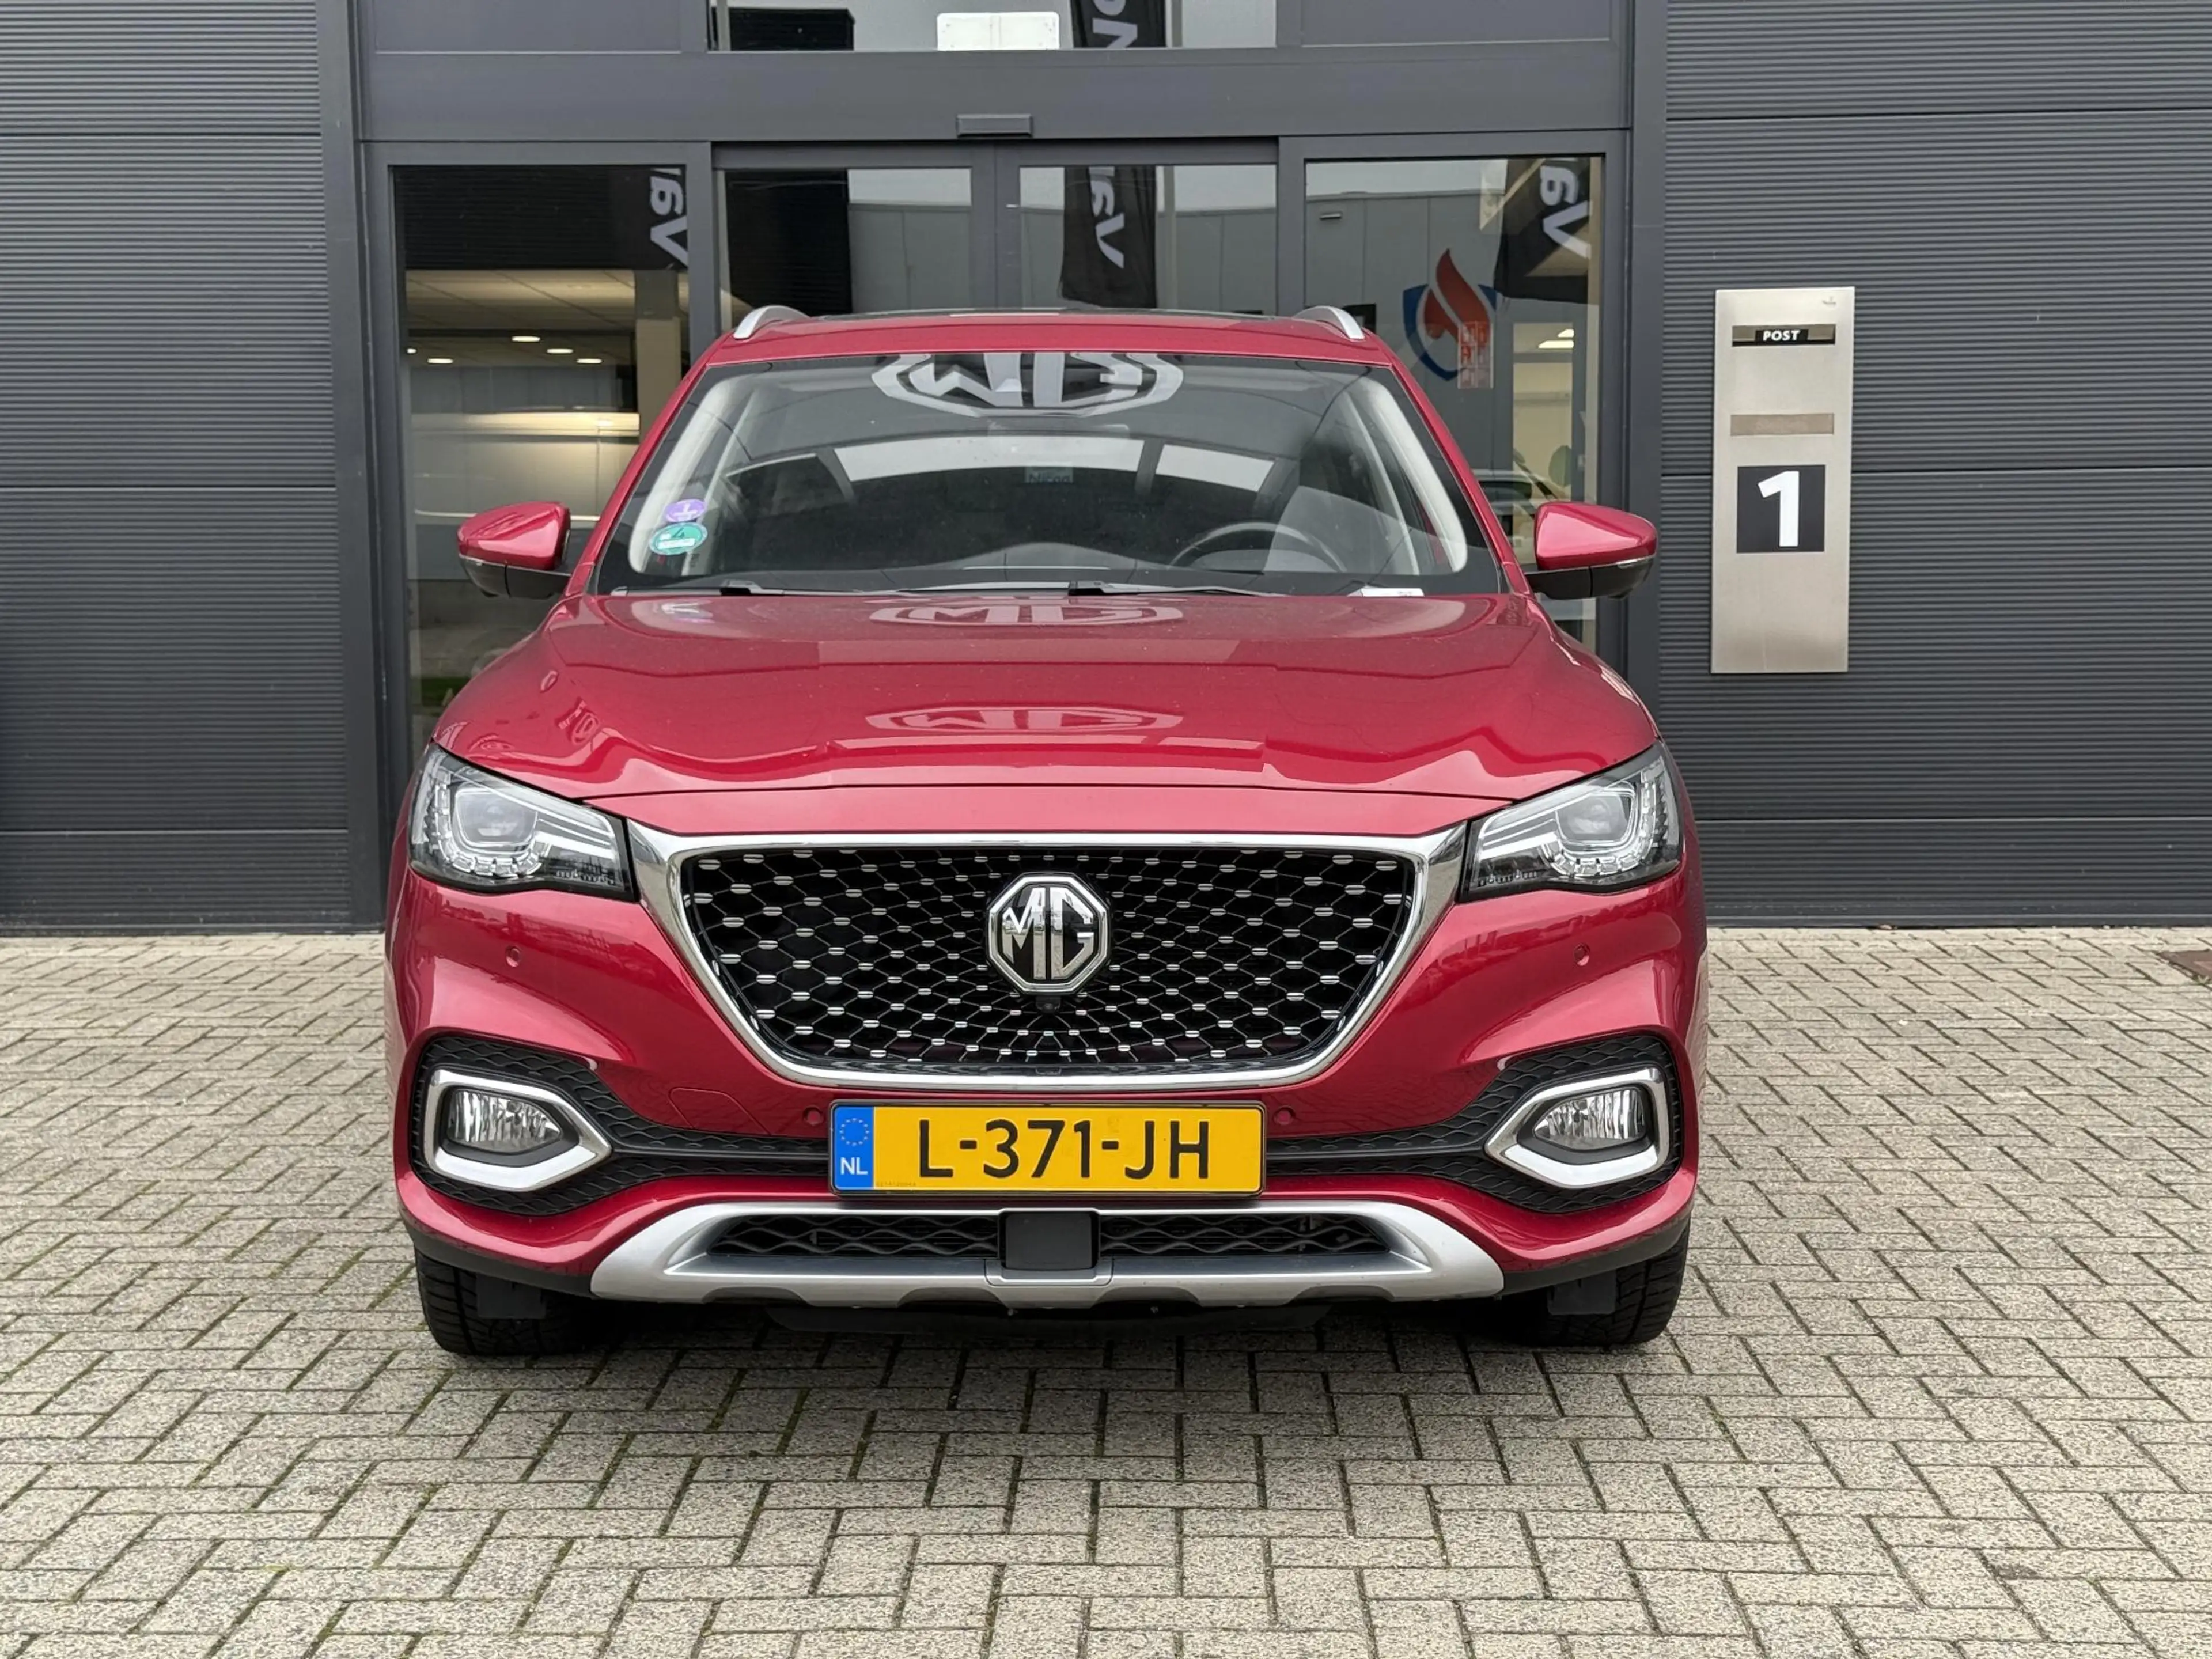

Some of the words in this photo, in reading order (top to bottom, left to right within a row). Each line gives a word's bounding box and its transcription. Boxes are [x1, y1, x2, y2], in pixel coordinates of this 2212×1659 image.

[1763, 329, 1800, 342] POST
[1758, 471, 1800, 547] 1
[1002, 887, 1094, 980] MG
[840, 1156, 869, 1175] NL
[919, 1119, 1209, 1180] L-371-JH
